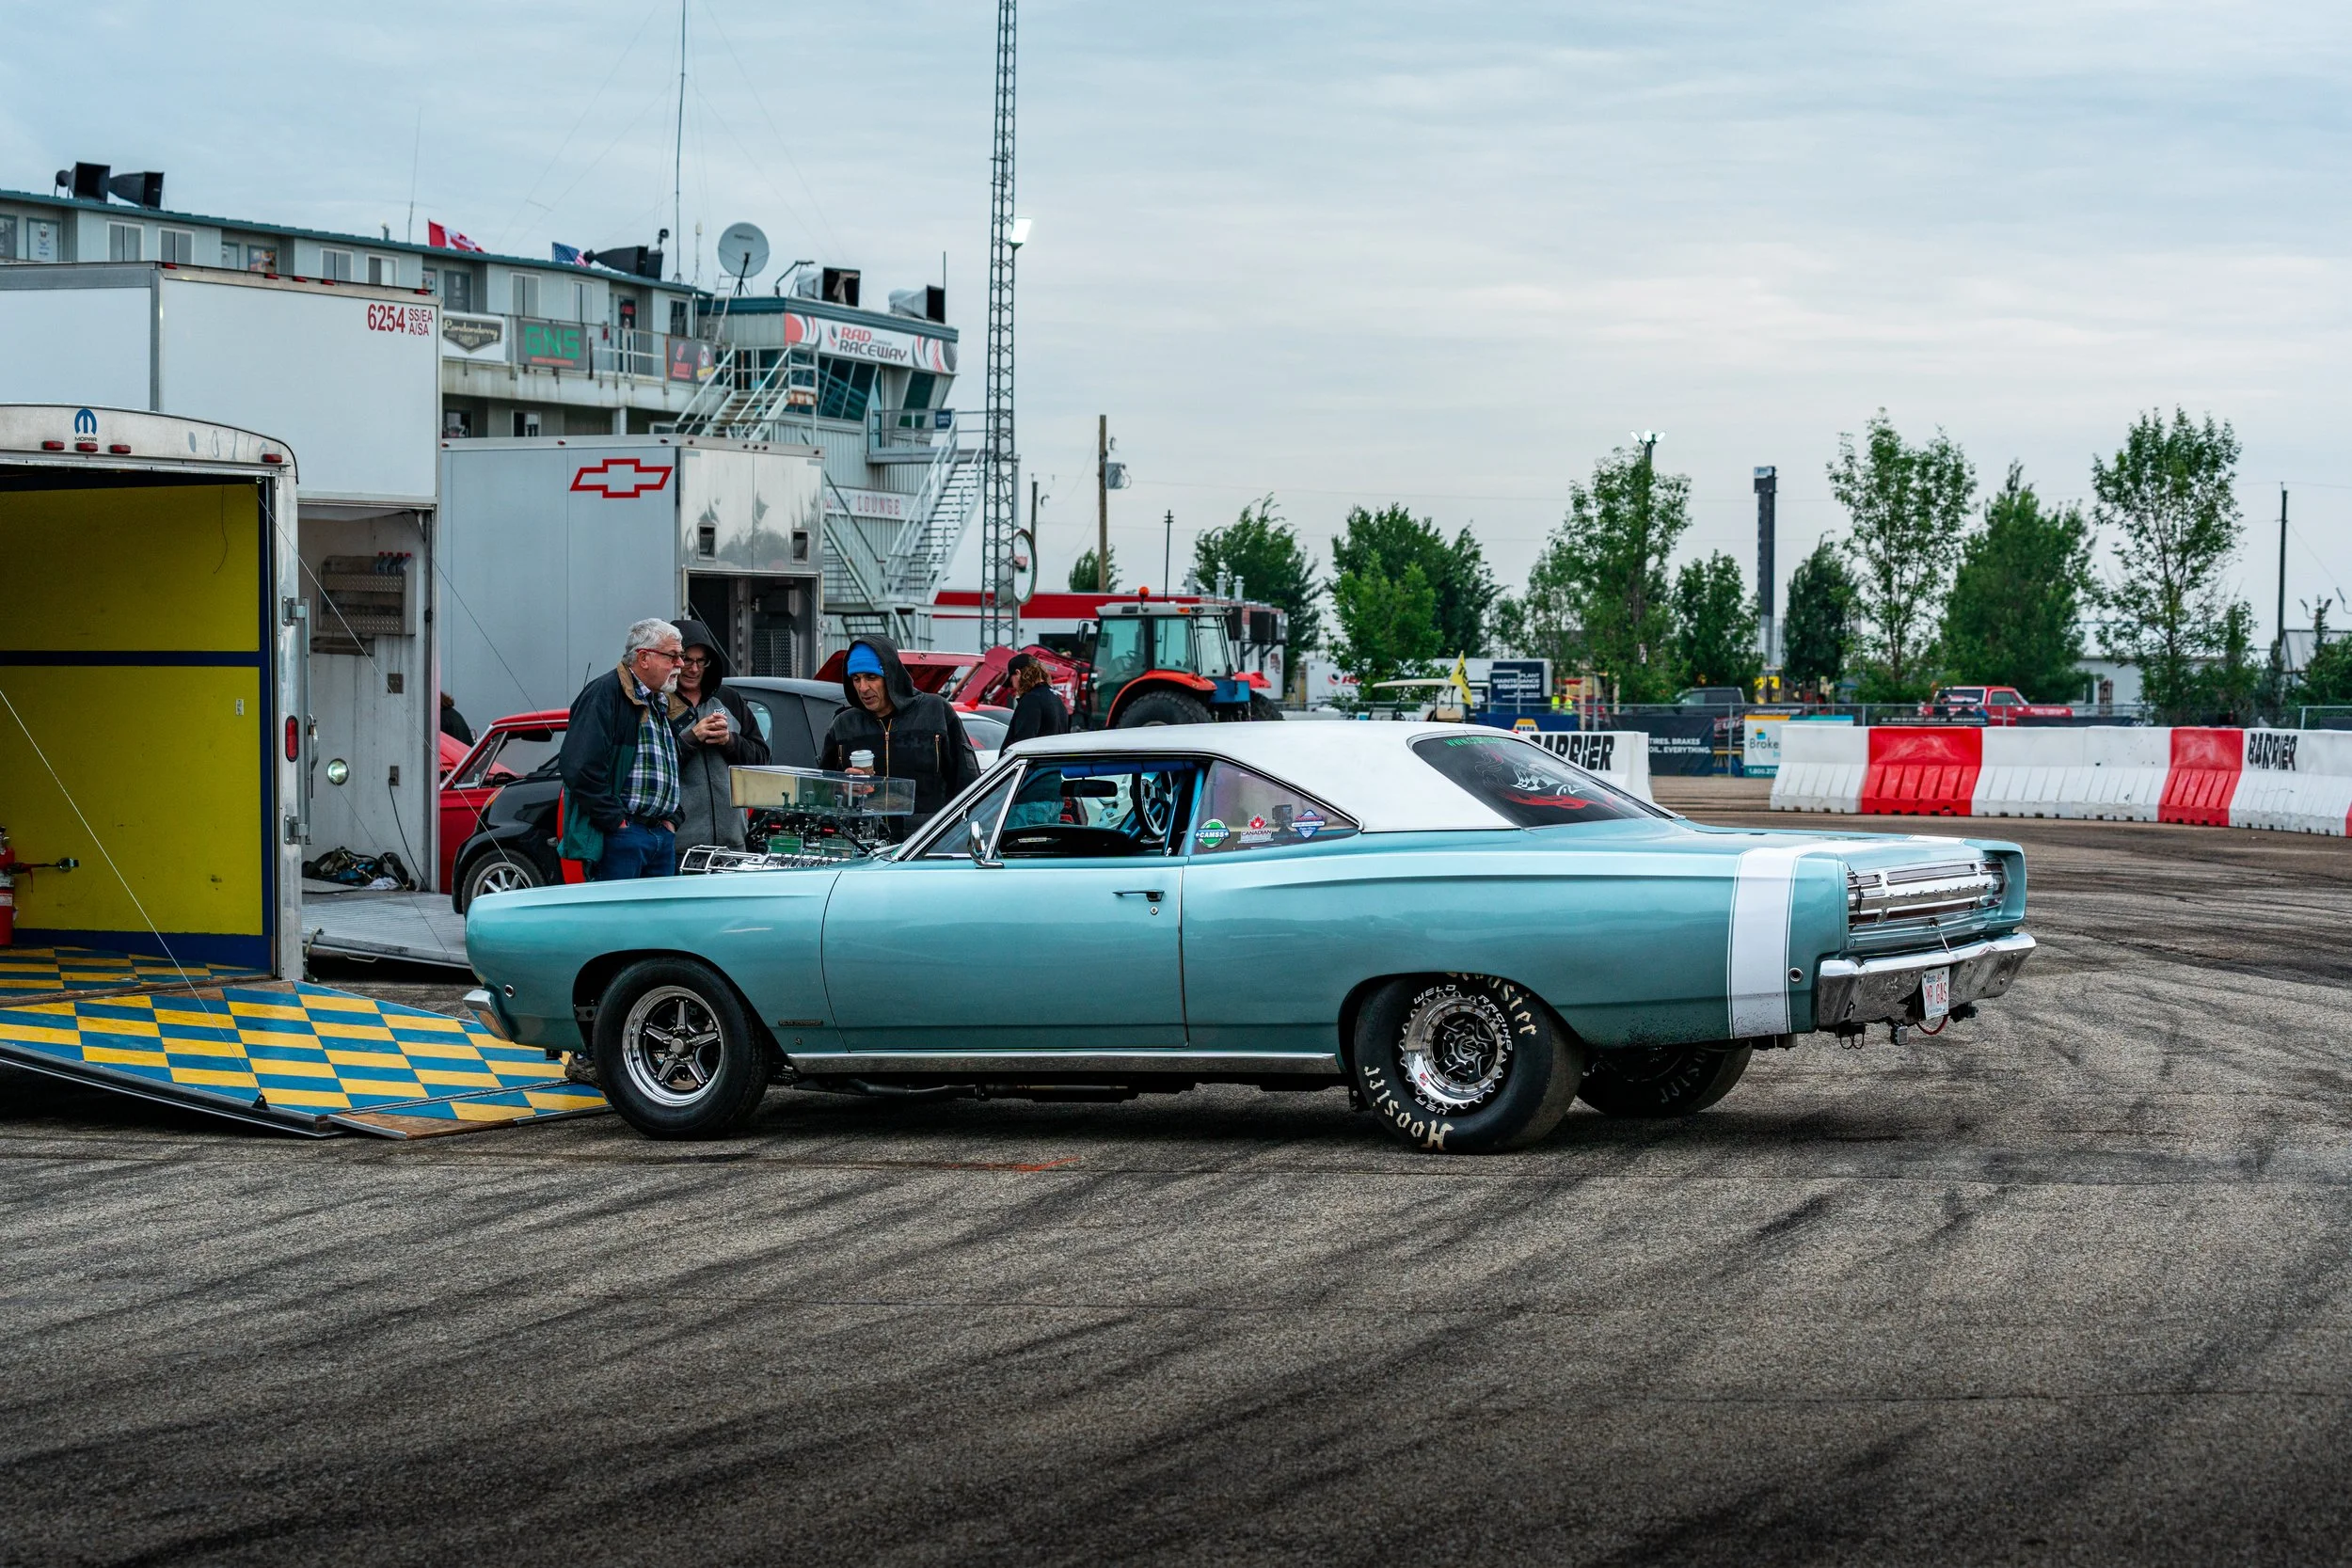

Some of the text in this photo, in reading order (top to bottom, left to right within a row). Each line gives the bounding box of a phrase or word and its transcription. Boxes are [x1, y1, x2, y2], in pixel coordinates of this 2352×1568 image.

[367, 303, 405, 333] 6254
[408, 308, 433, 324] SS/EA
[408, 323, 430, 336] A/SA
[840, 325, 872, 343] RAD
[525, 325, 580, 359] GNS
[838, 339, 908, 362] RACEWAY
[857, 494, 901, 515] LOUNGE
[1672, 737, 1701, 746] BRAKES
[2248, 733, 2297, 771] BARRIER
[1530, 735, 1614, 771] RRIER
[1200, 831, 1225, 839] CAMSS
[1241, 829, 1272, 837] CANADIAN
[1413, 984, 1513, 1052] WELD RACING
[1363, 1065, 1455, 1151] Hoosier
[1414, 1095, 1449, 1116] USA
